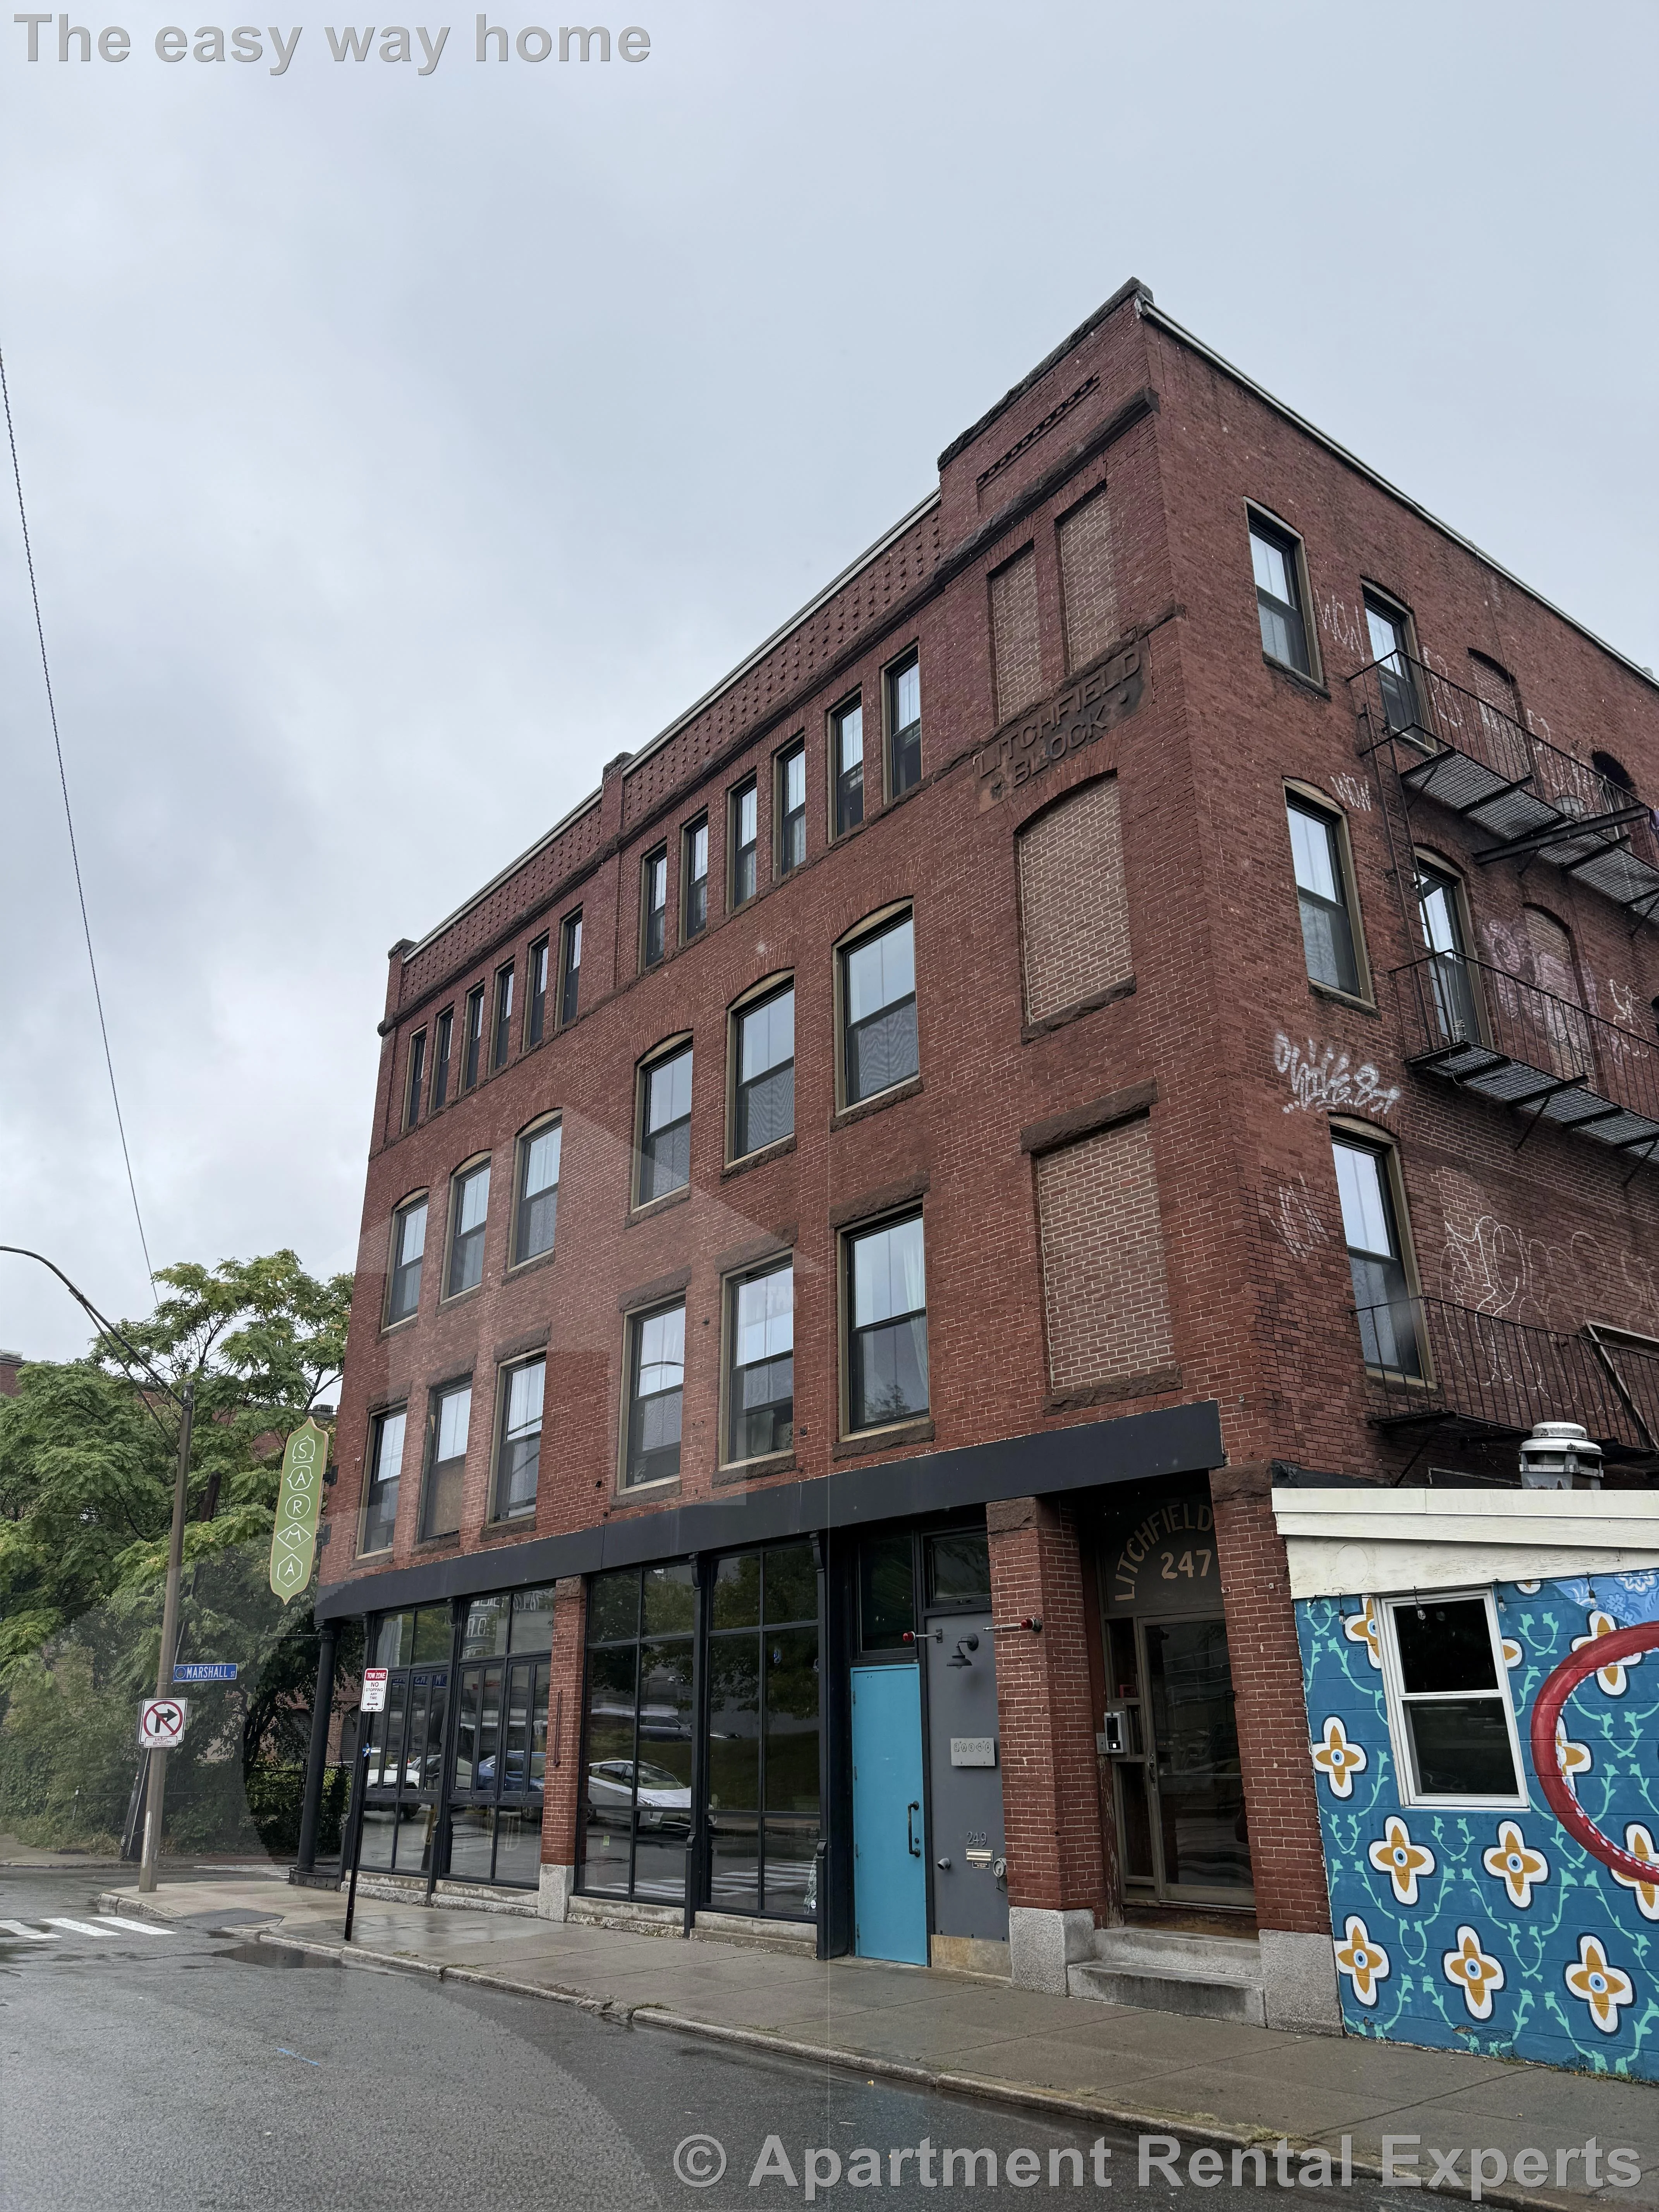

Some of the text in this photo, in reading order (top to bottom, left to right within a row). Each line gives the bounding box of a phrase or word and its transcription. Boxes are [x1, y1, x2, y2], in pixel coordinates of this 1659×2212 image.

[979, 651, 1140, 778] LITCHFIELD
[1013, 704, 1107, 788] BLOCK
[281, 1439, 310, 1581] SARMA
[1115, 1503, 1213, 1601] LITCHFIELD
[1161, 1549, 1212, 1579] 247
[186, 1666, 228, 1678] MARSHALL
[967, 1831, 987, 1846] 249
